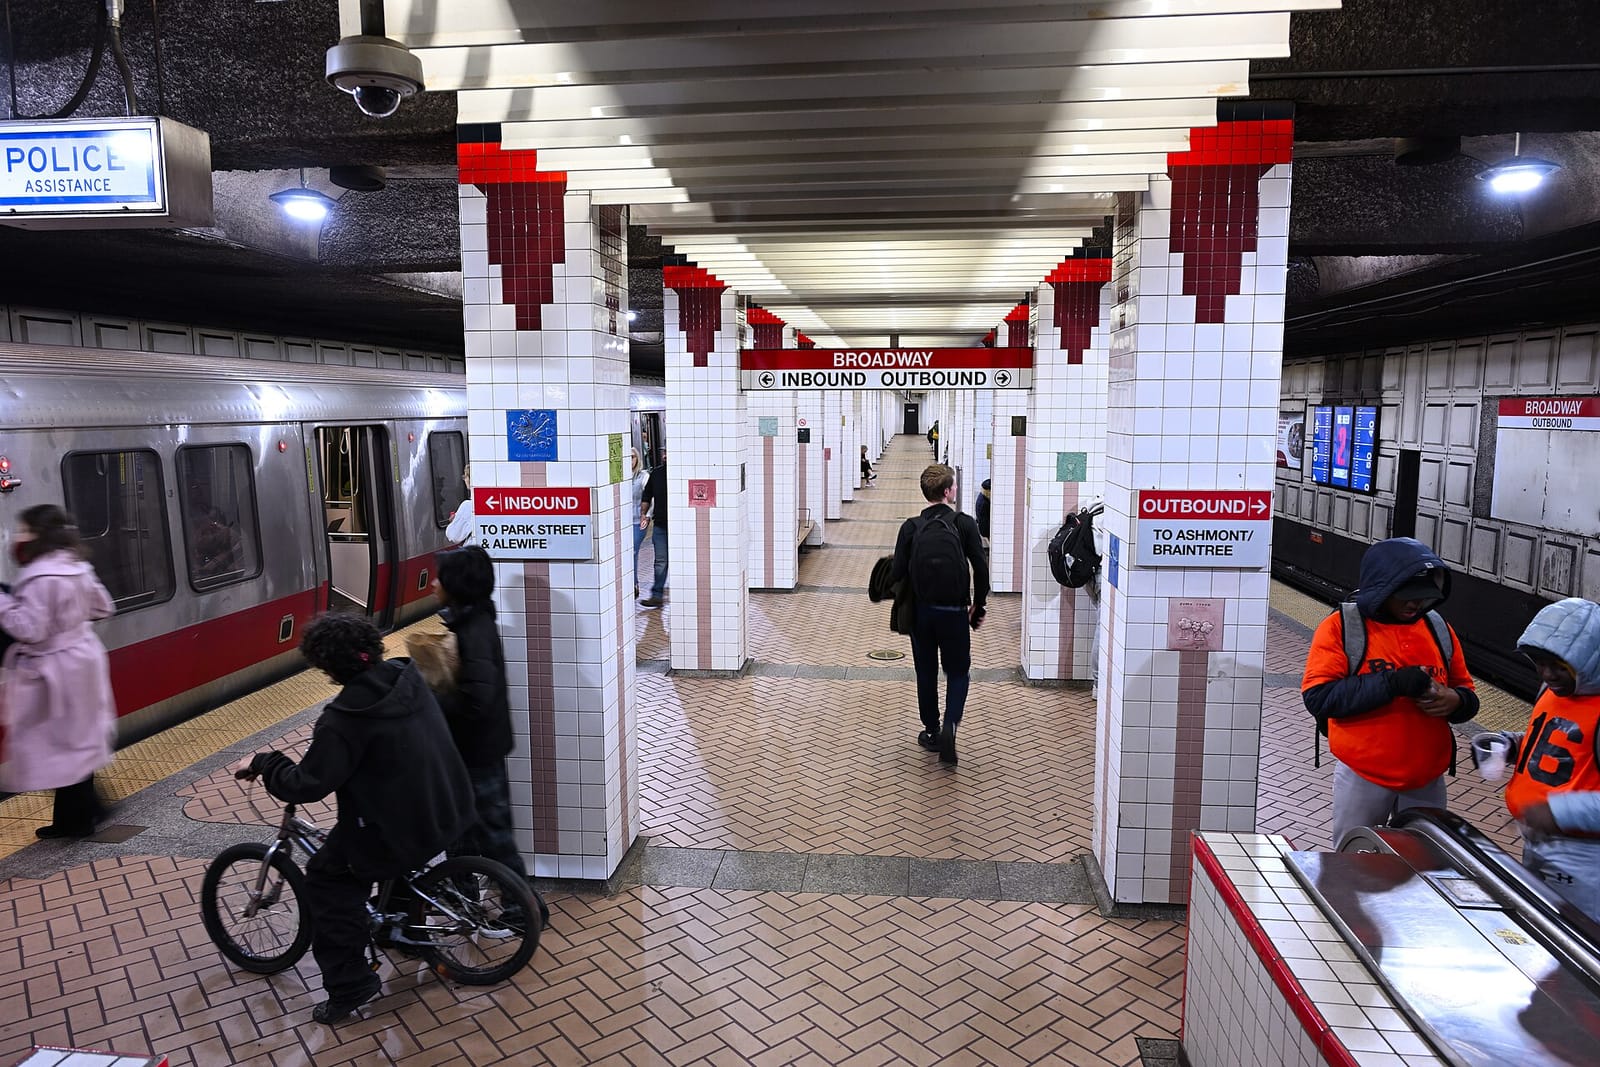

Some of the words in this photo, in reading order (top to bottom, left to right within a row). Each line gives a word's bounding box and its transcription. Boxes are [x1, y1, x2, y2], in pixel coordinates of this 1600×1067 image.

[6, 145, 126, 173] POLICE
[25, 178, 111, 193] ASSISTANCE
[833, 352, 934, 367] BROADWAY
[782, 372, 867, 387] INBOUND
[881, 371, 987, 386] OUTBOUND
[1525, 400, 1583, 415] BROADWAY
[1532, 417, 1573, 428] OUTBOUND
[504, 496, 579, 510] INBOUND
[1142, 499, 1246, 514] OUTBOUND
[480, 524, 498, 535] TO
[501, 524, 535, 535] PARK
[537, 524, 586, 535] STREET
[1153, 529, 1173, 541] TO
[1176, 529, 1254, 542] ASHMONT/
[481, 538, 490, 549] &
[493, 538, 547, 549] ALEWIFE
[1153, 544, 1233, 556] BRAINTREE
[1517, 711, 1584, 788] 16
